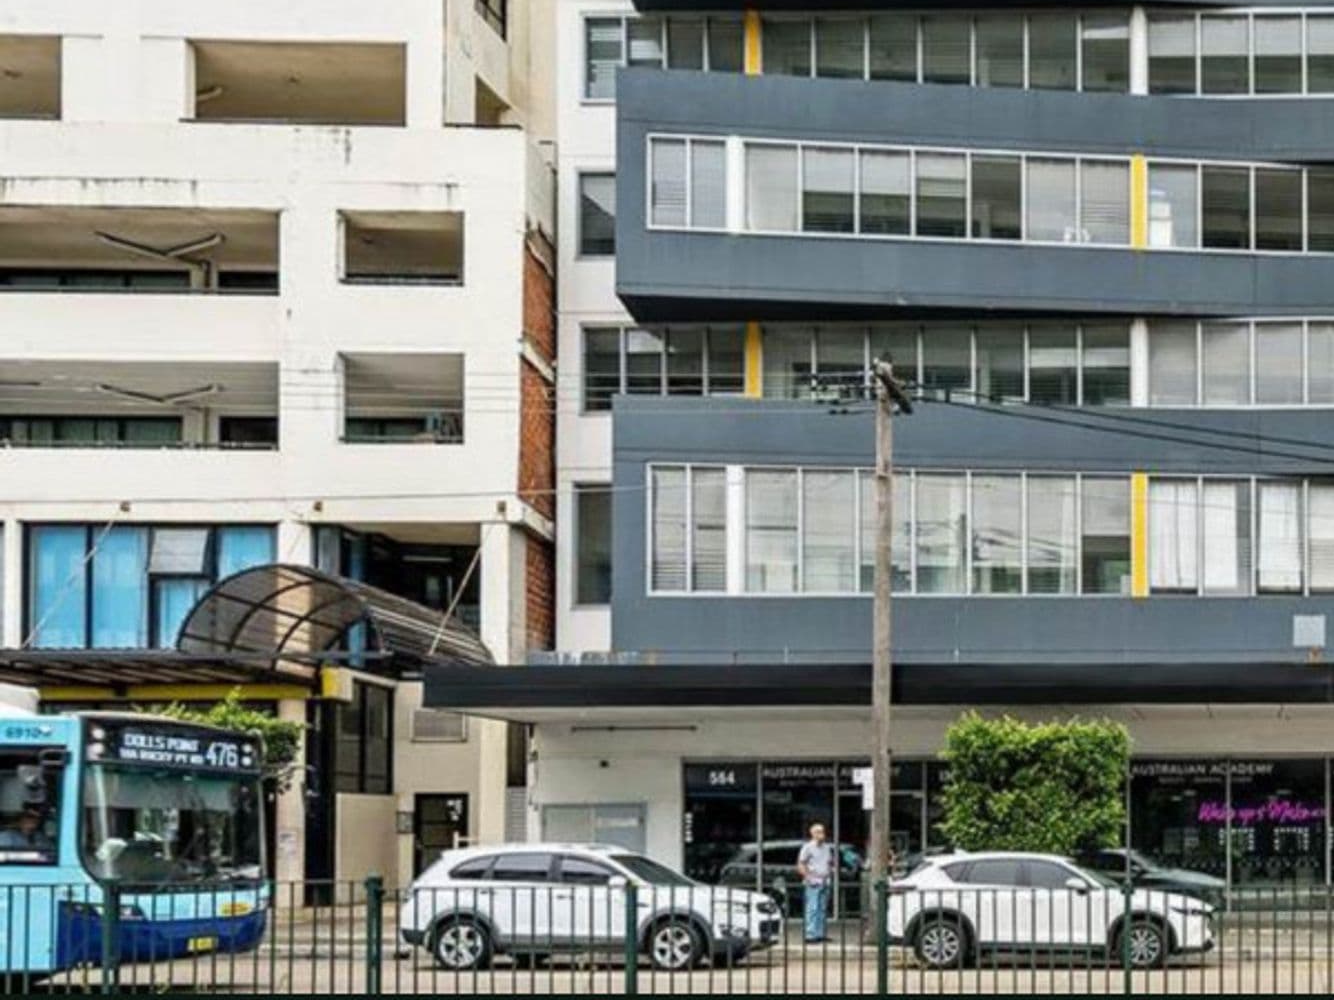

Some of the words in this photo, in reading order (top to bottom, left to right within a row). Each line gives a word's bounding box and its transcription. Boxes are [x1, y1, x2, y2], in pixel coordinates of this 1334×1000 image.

[124, 734, 166, 749] DOLLS
[206, 742, 239, 767] 476
[1132, 764, 1205, 775] AUSTRALIAN
[1210, 763, 1273, 774] ACADEMY
